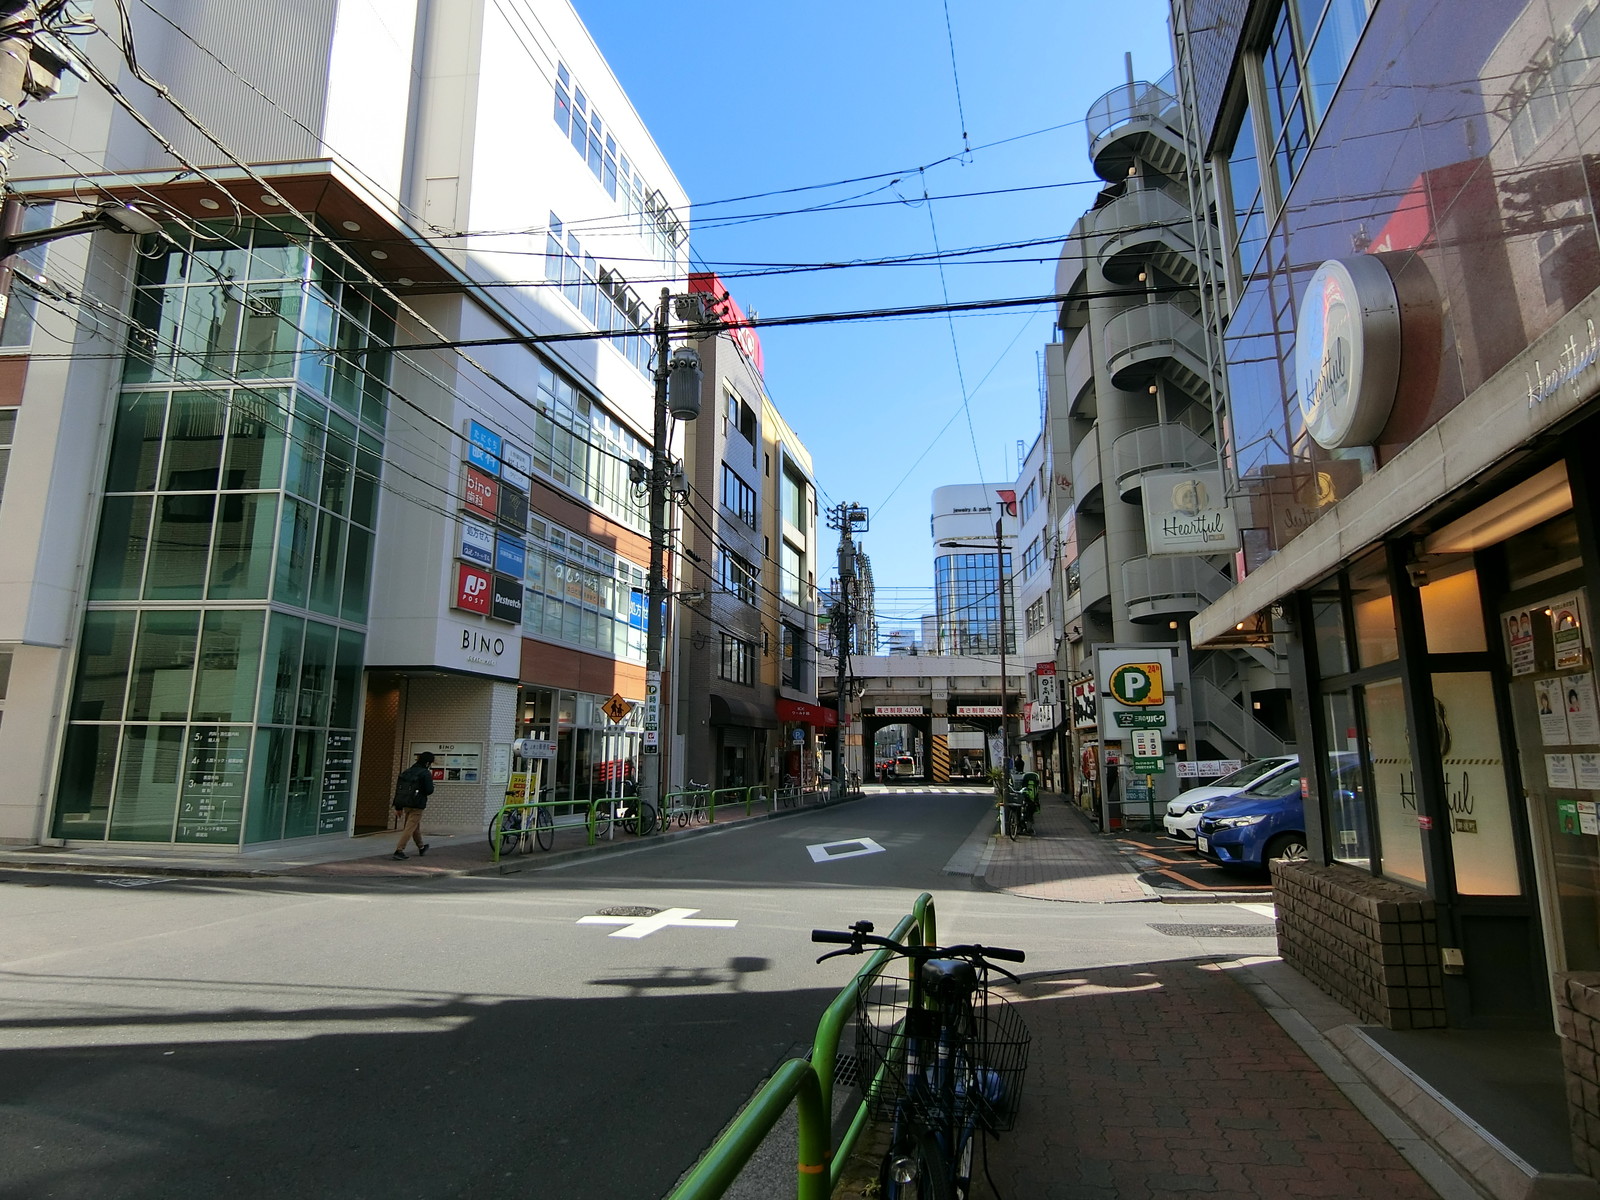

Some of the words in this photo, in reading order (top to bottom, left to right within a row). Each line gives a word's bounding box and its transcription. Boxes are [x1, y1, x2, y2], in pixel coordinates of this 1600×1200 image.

[1305, 336, 1345, 407] Heartful
[1525, 318, 1600, 409] Heartful
[473, 429, 497, 449] たにぐち
[467, 474, 492, 497] bino
[466, 490, 483, 507] 歯科
[466, 525, 490, 543] 処方せん
[1163, 513, 1224, 543] Heartful
[462, 594, 484, 605] POST
[462, 629, 504, 656] BINO
[1147, 665, 1160, 674] 24h
[1123, 672, 1146, 698] P
